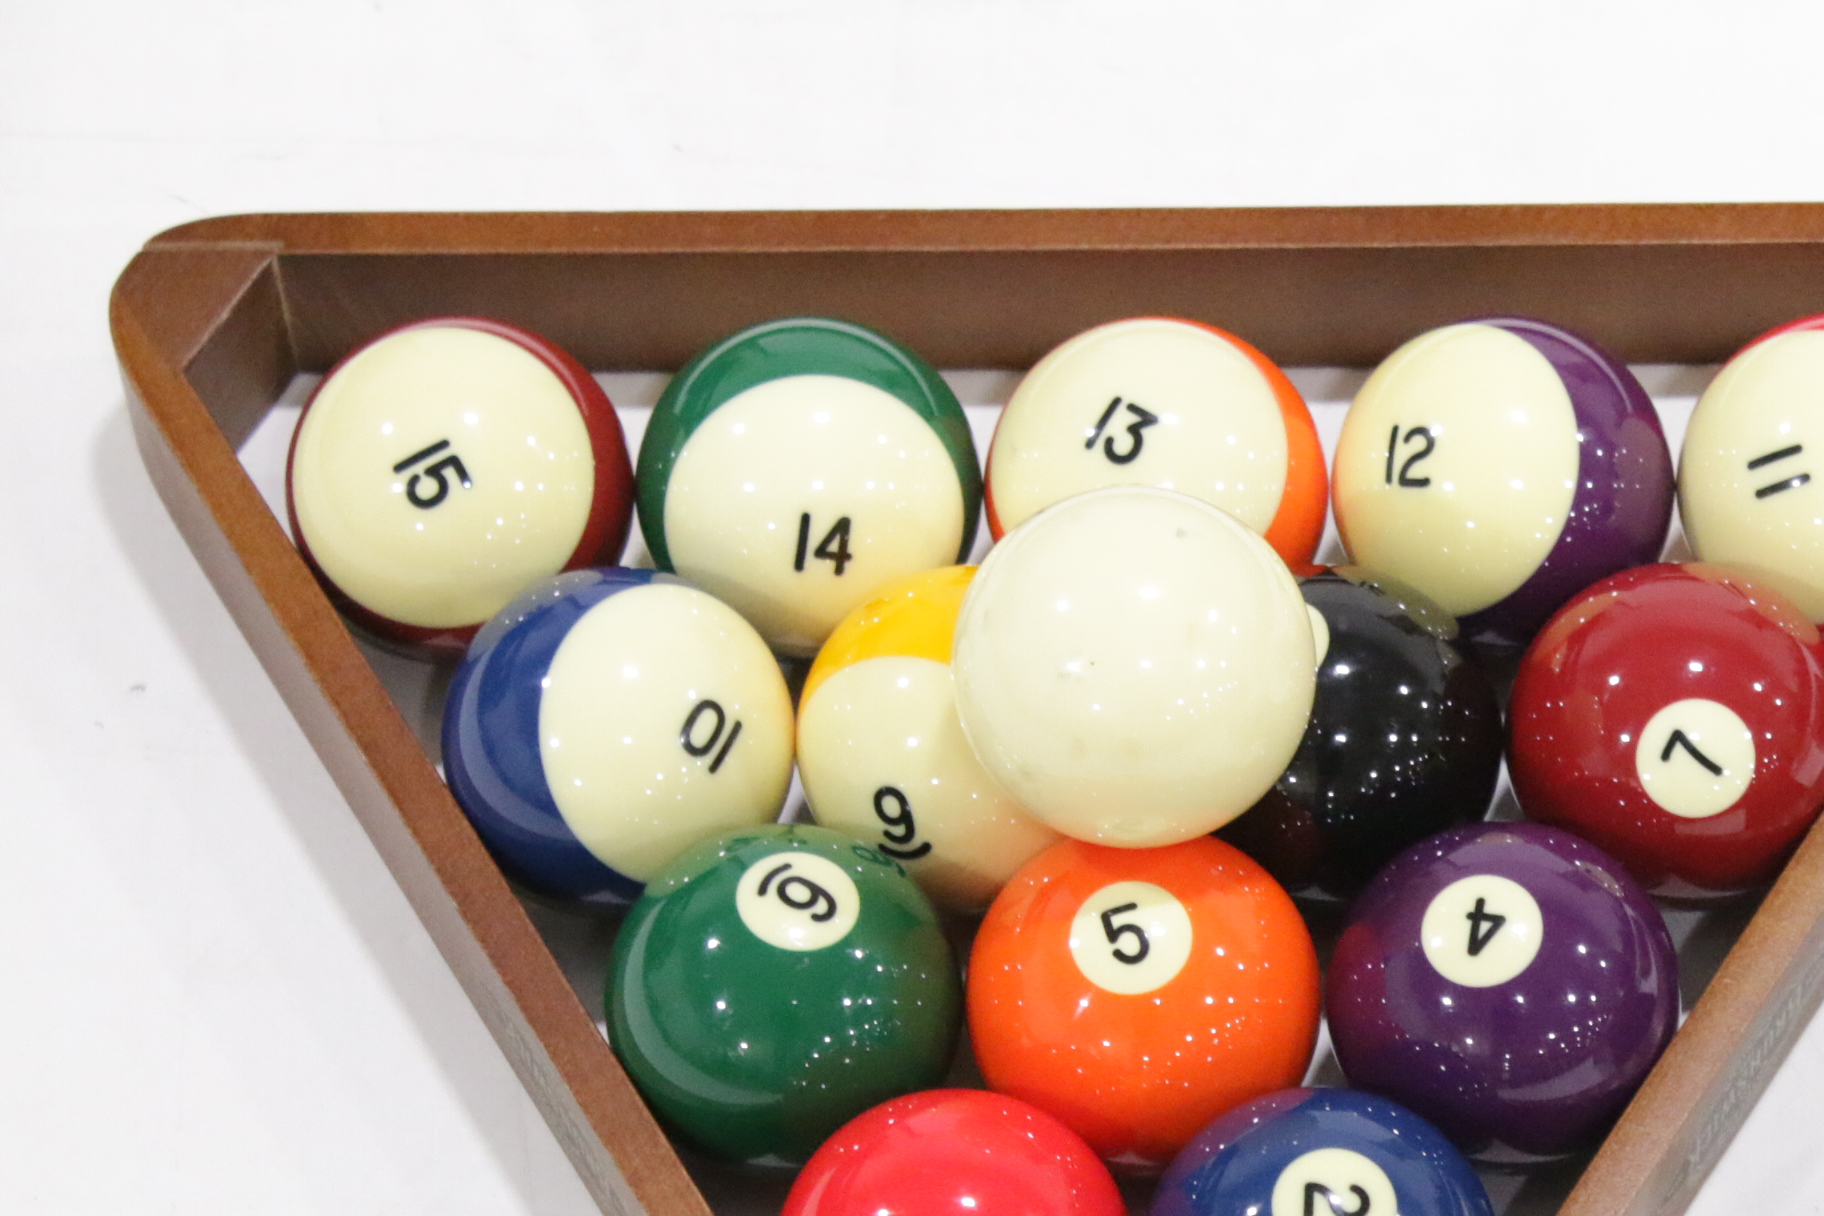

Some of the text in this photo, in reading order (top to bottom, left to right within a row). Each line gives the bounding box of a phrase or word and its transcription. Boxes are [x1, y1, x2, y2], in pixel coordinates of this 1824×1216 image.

[1085, 396, 1160, 467] 13
[1384, 423, 1437, 489] 12
[392, 438, 472, 510] 15
[1746, 443, 1812, 500] 11
[794, 511, 853, 577] 14
[680, 698, 743, 775] 10
[1660, 727, 1723, 777] 7
[872, 784, 917, 849] 9
[775, 875, 838, 923] 6
[1464, 896, 1508, 957] 4
[1099, 901, 1150, 966] 5
